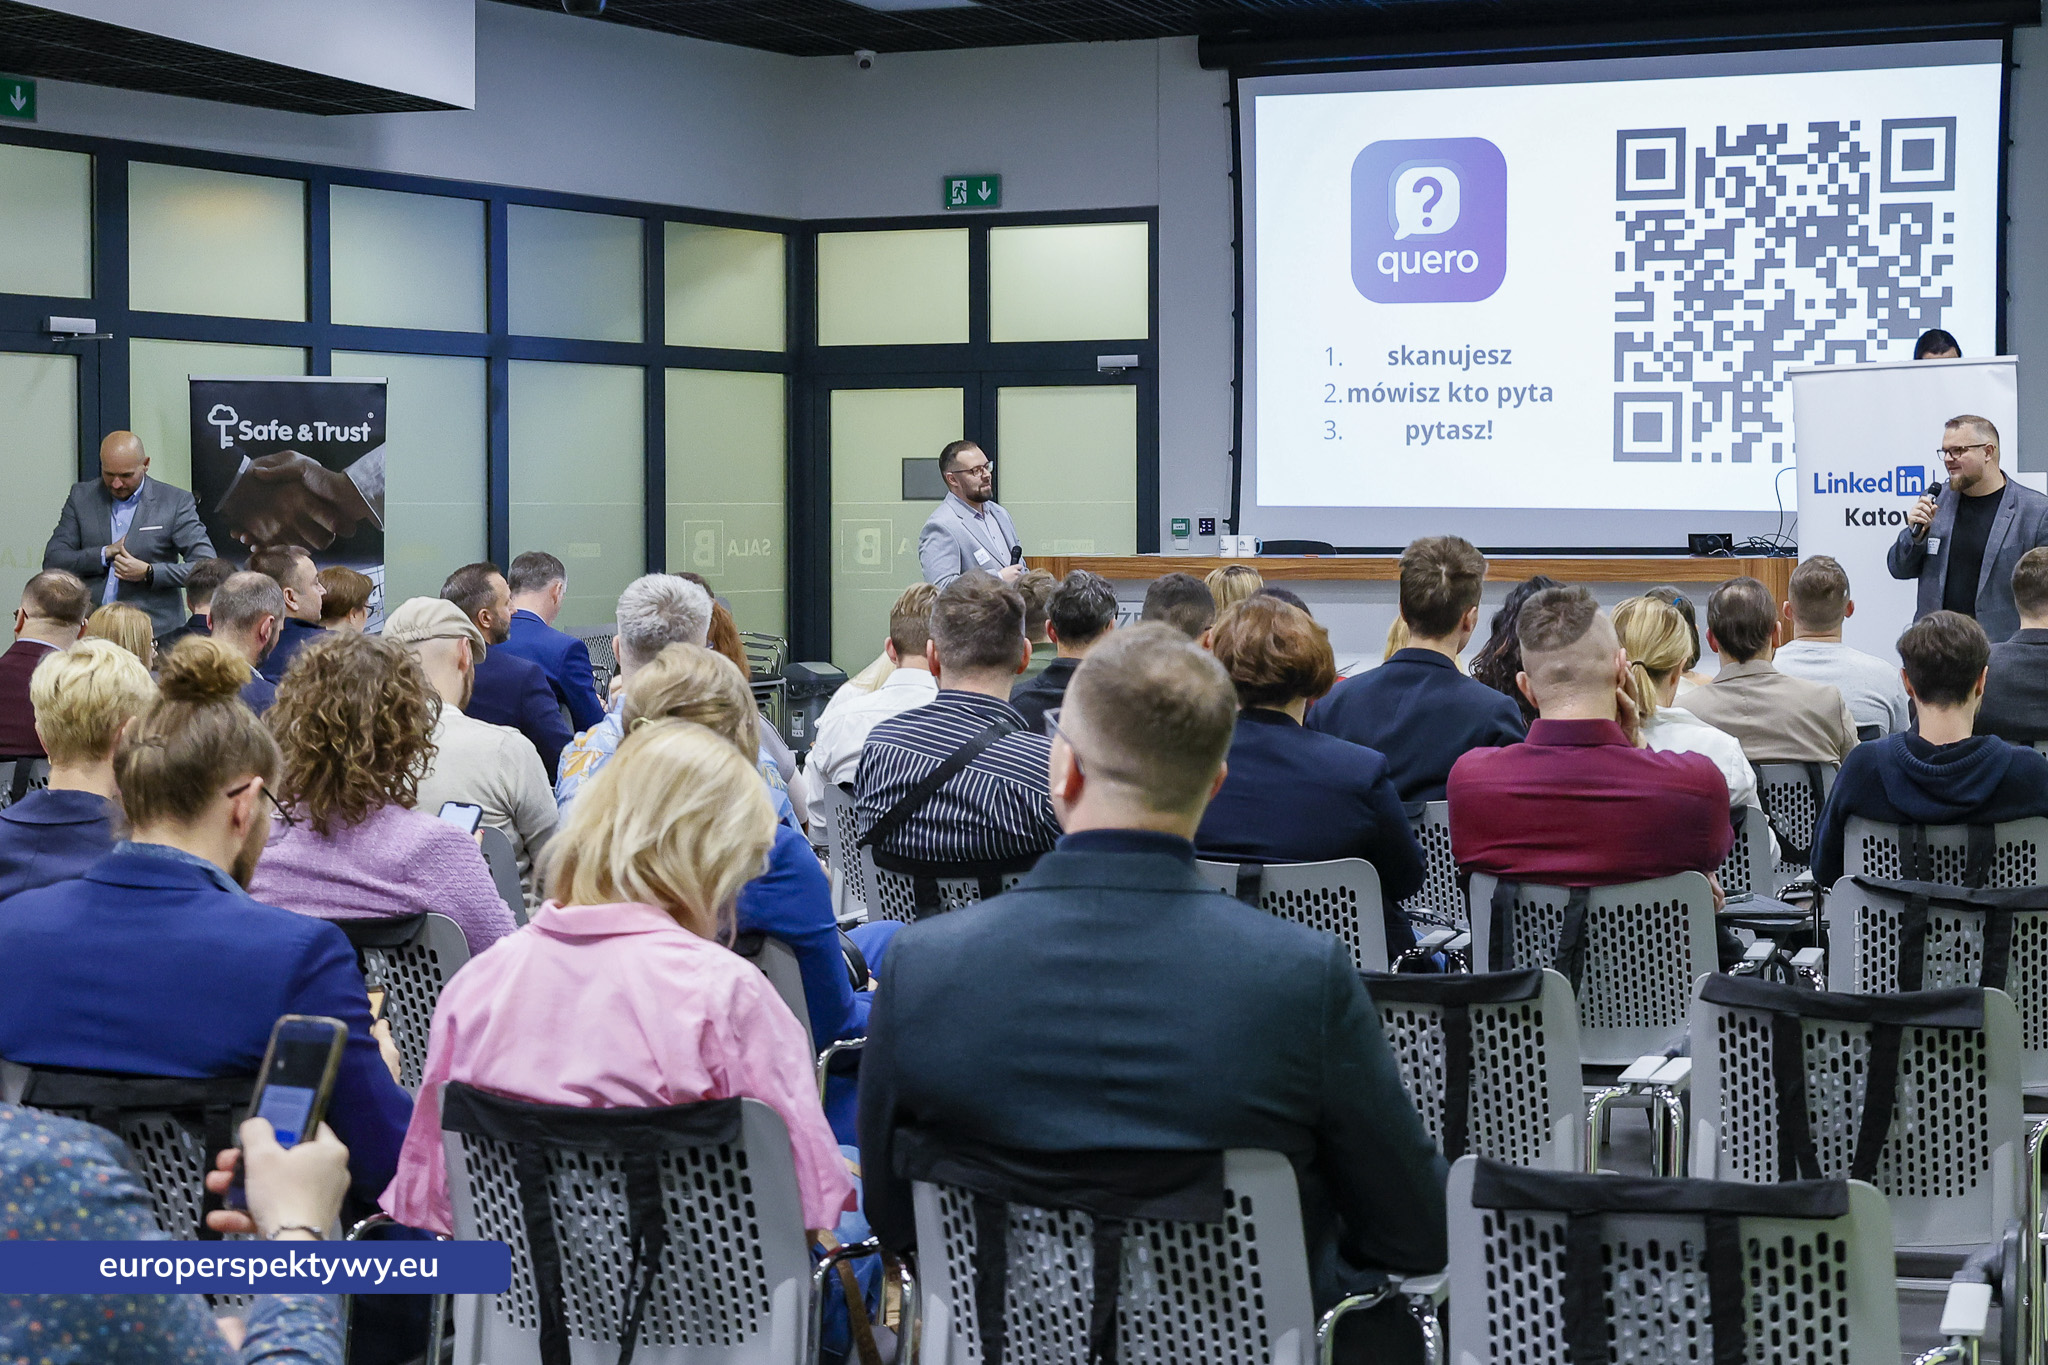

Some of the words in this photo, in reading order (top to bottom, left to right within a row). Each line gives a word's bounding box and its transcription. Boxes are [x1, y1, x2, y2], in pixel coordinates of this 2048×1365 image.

[1377, 249, 1479, 283] quero
[1325, 346, 1343, 367] 1.
[1388, 344, 1512, 372] skanujesz
[1324, 383, 1343, 404] 2.
[1348, 381, 1440, 403] mówisz
[1448, 381, 1489, 403] kto
[1498, 383, 1553, 409] pyta
[238, 419, 293, 441] Safe
[1323, 420, 1343, 440] 3.
[1406, 419, 1493, 446] pytasz!
[1845, 507, 1909, 527] Kato
